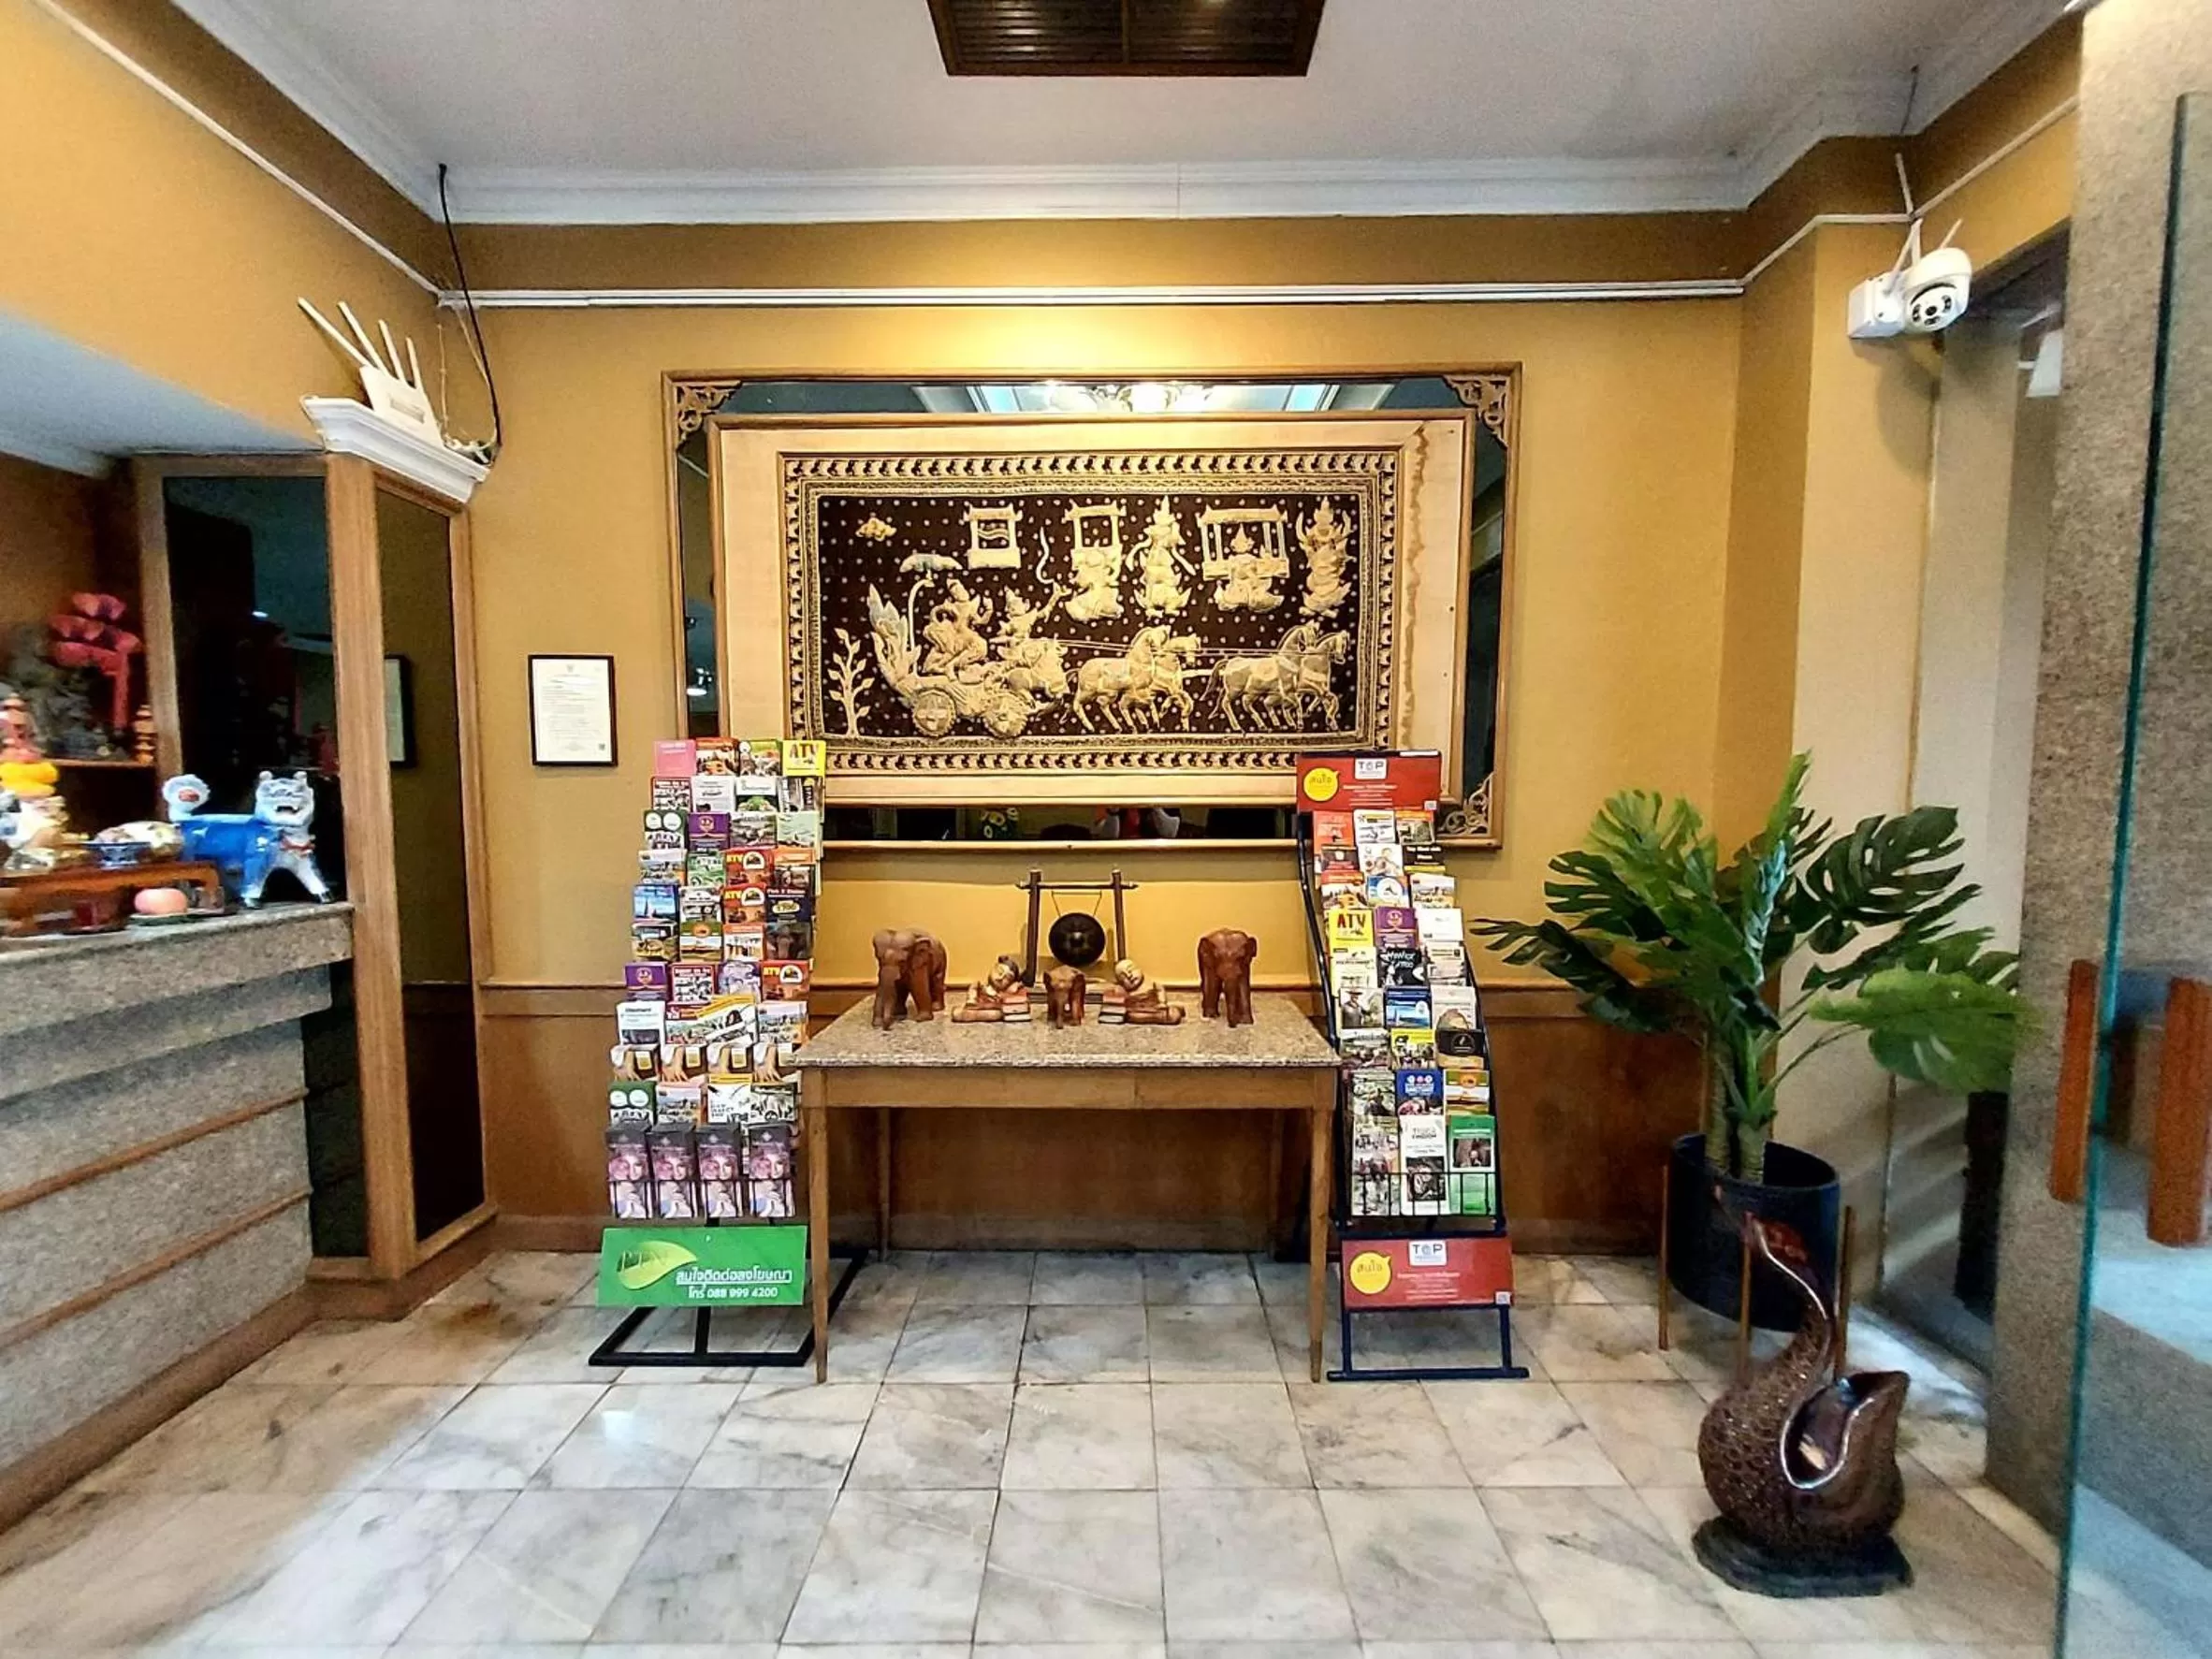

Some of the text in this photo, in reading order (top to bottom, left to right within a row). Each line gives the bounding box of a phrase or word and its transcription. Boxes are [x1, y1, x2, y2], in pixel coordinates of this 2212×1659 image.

[1337, 913, 1366, 929] ATV
[1412, 1244, 1443, 1255] TOP
[750, 1287, 779, 1298] 4200
